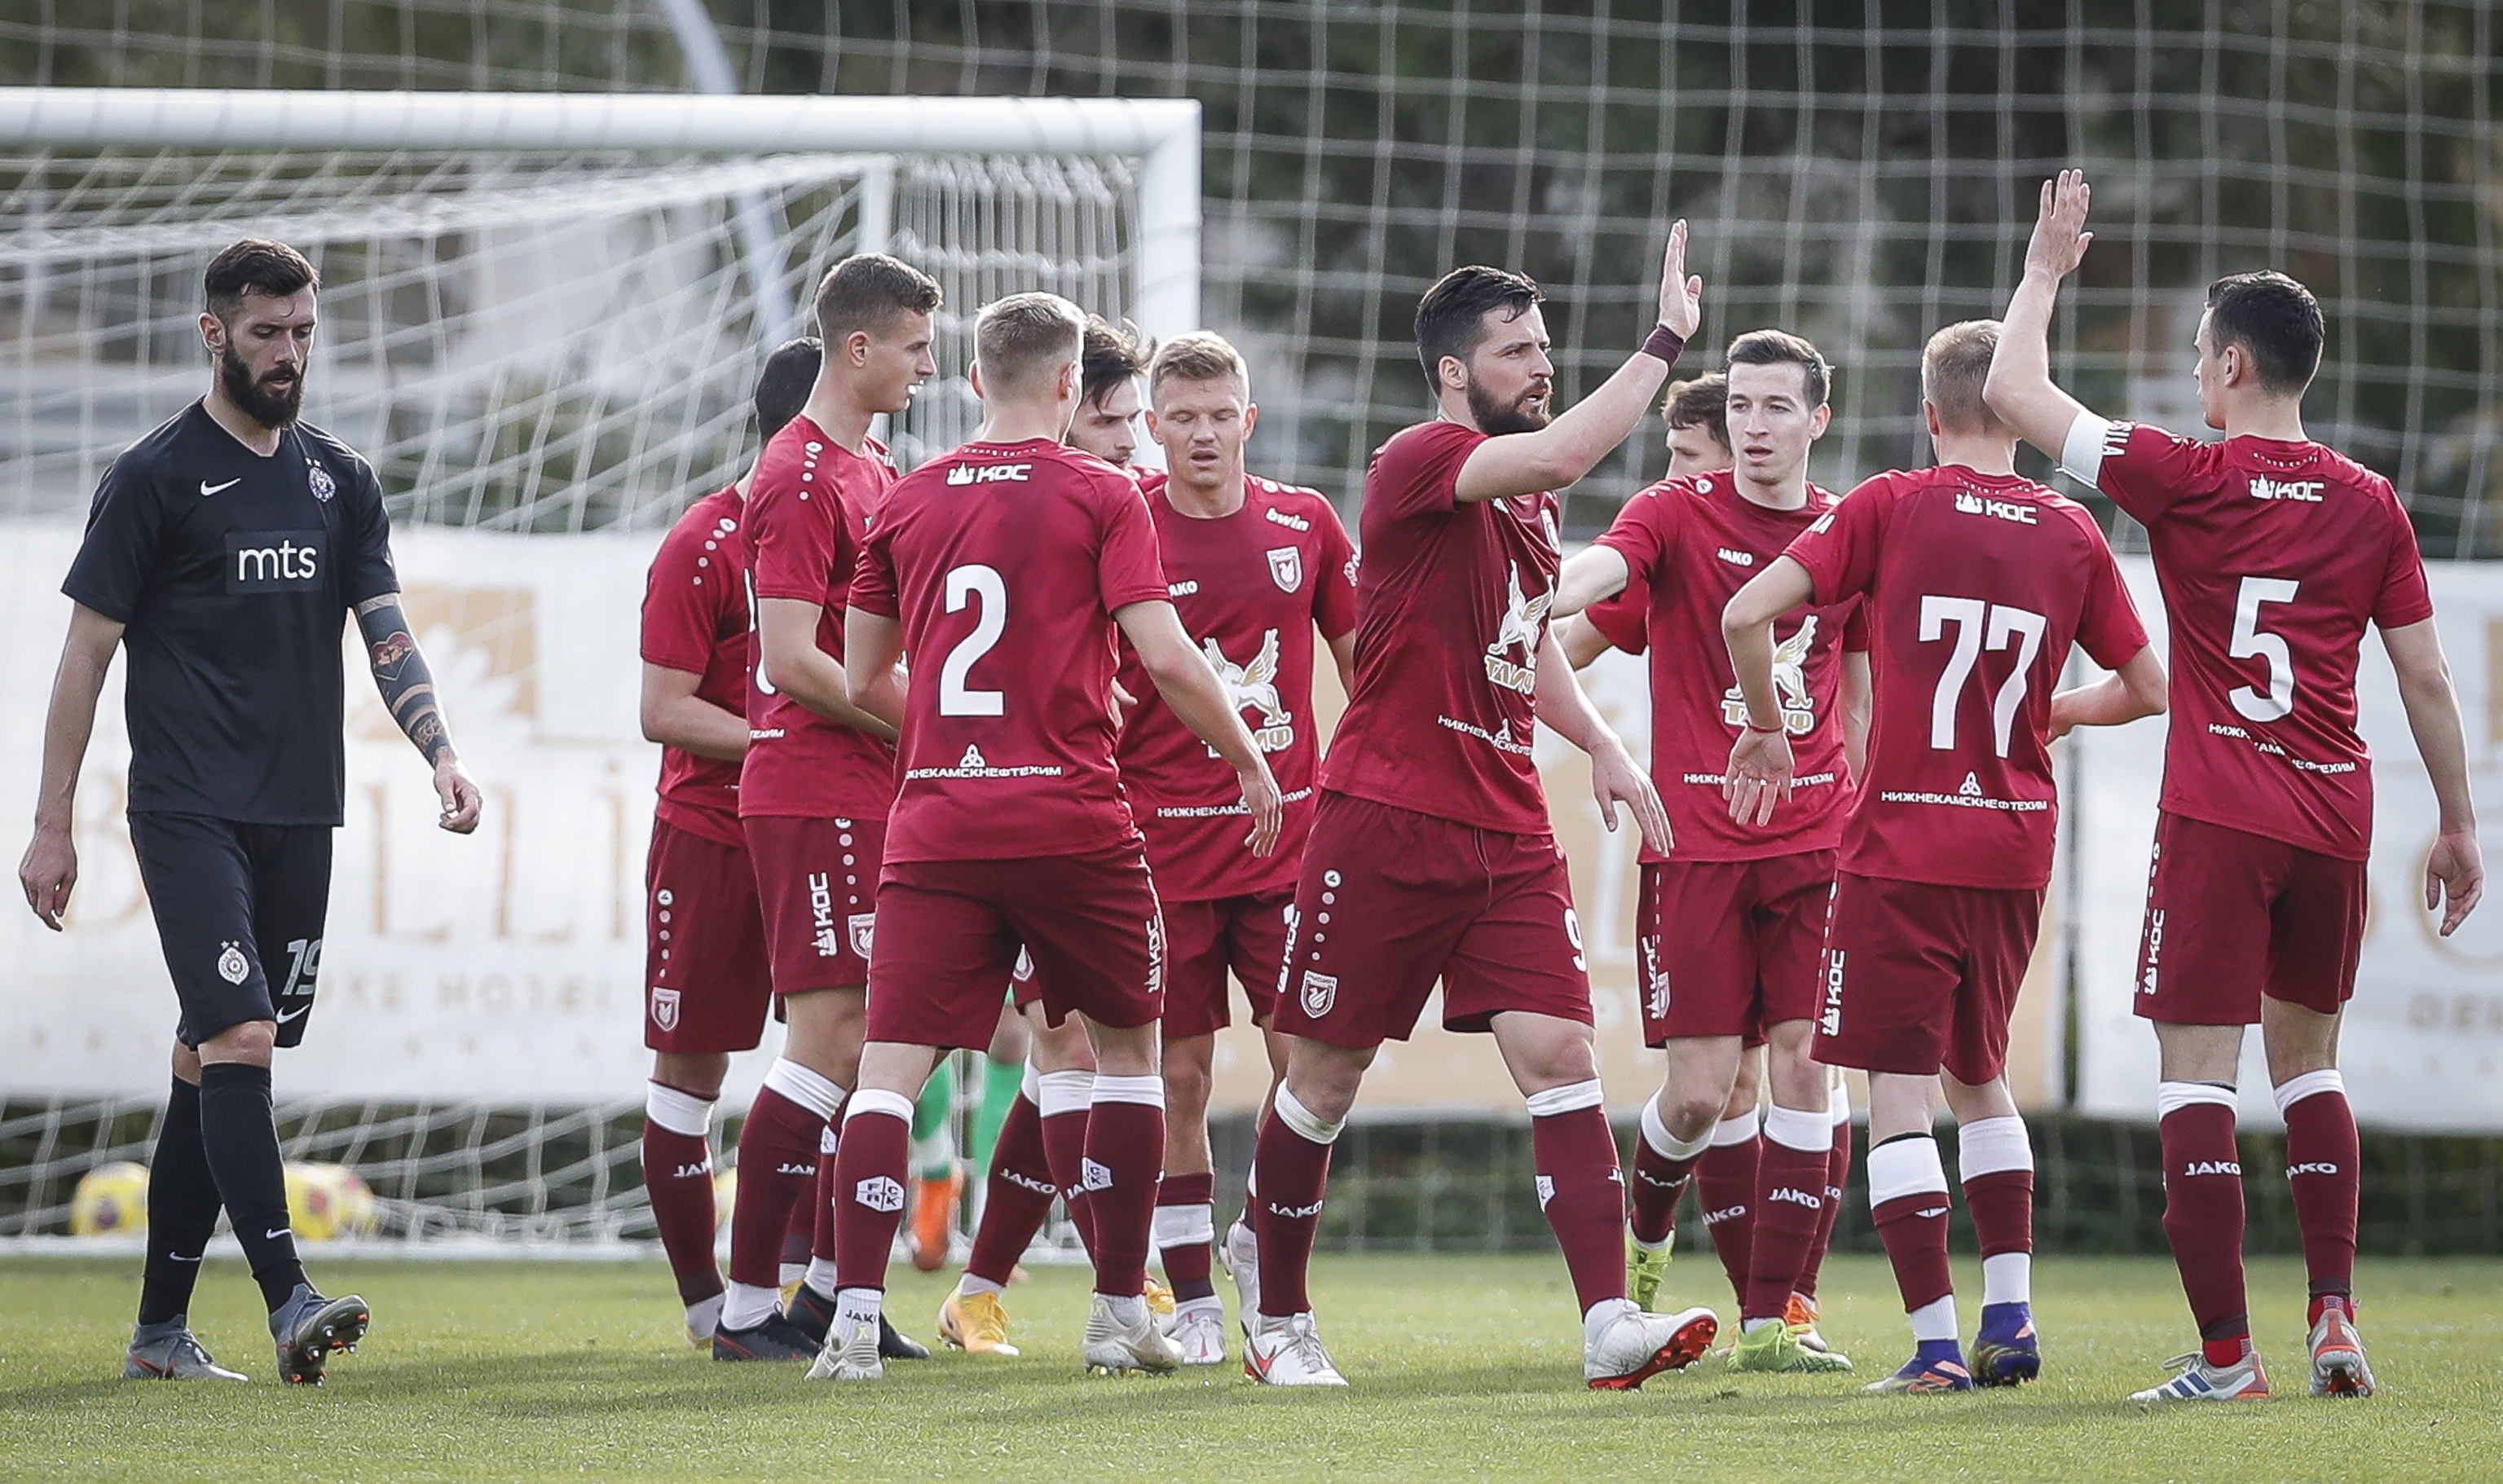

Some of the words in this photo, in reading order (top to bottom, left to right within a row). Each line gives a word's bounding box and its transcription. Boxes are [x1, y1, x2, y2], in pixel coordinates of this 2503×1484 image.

[1265, 508, 1310, 531] bwin
[239, 539, 317, 581] mts
[1716, 548, 1753, 567] JAKO
[1168, 580, 1199, 597] AKO
[939, 564, 1009, 717] 2
[2228, 575, 2300, 723] 5
[1919, 595, 2048, 759] 77
[1563, 907, 1589, 973] 9
[281, 939, 321, 996] 19
[2184, 1160, 2241, 1177] JAKO
[1769, 1187, 1822, 1209] JAKO
